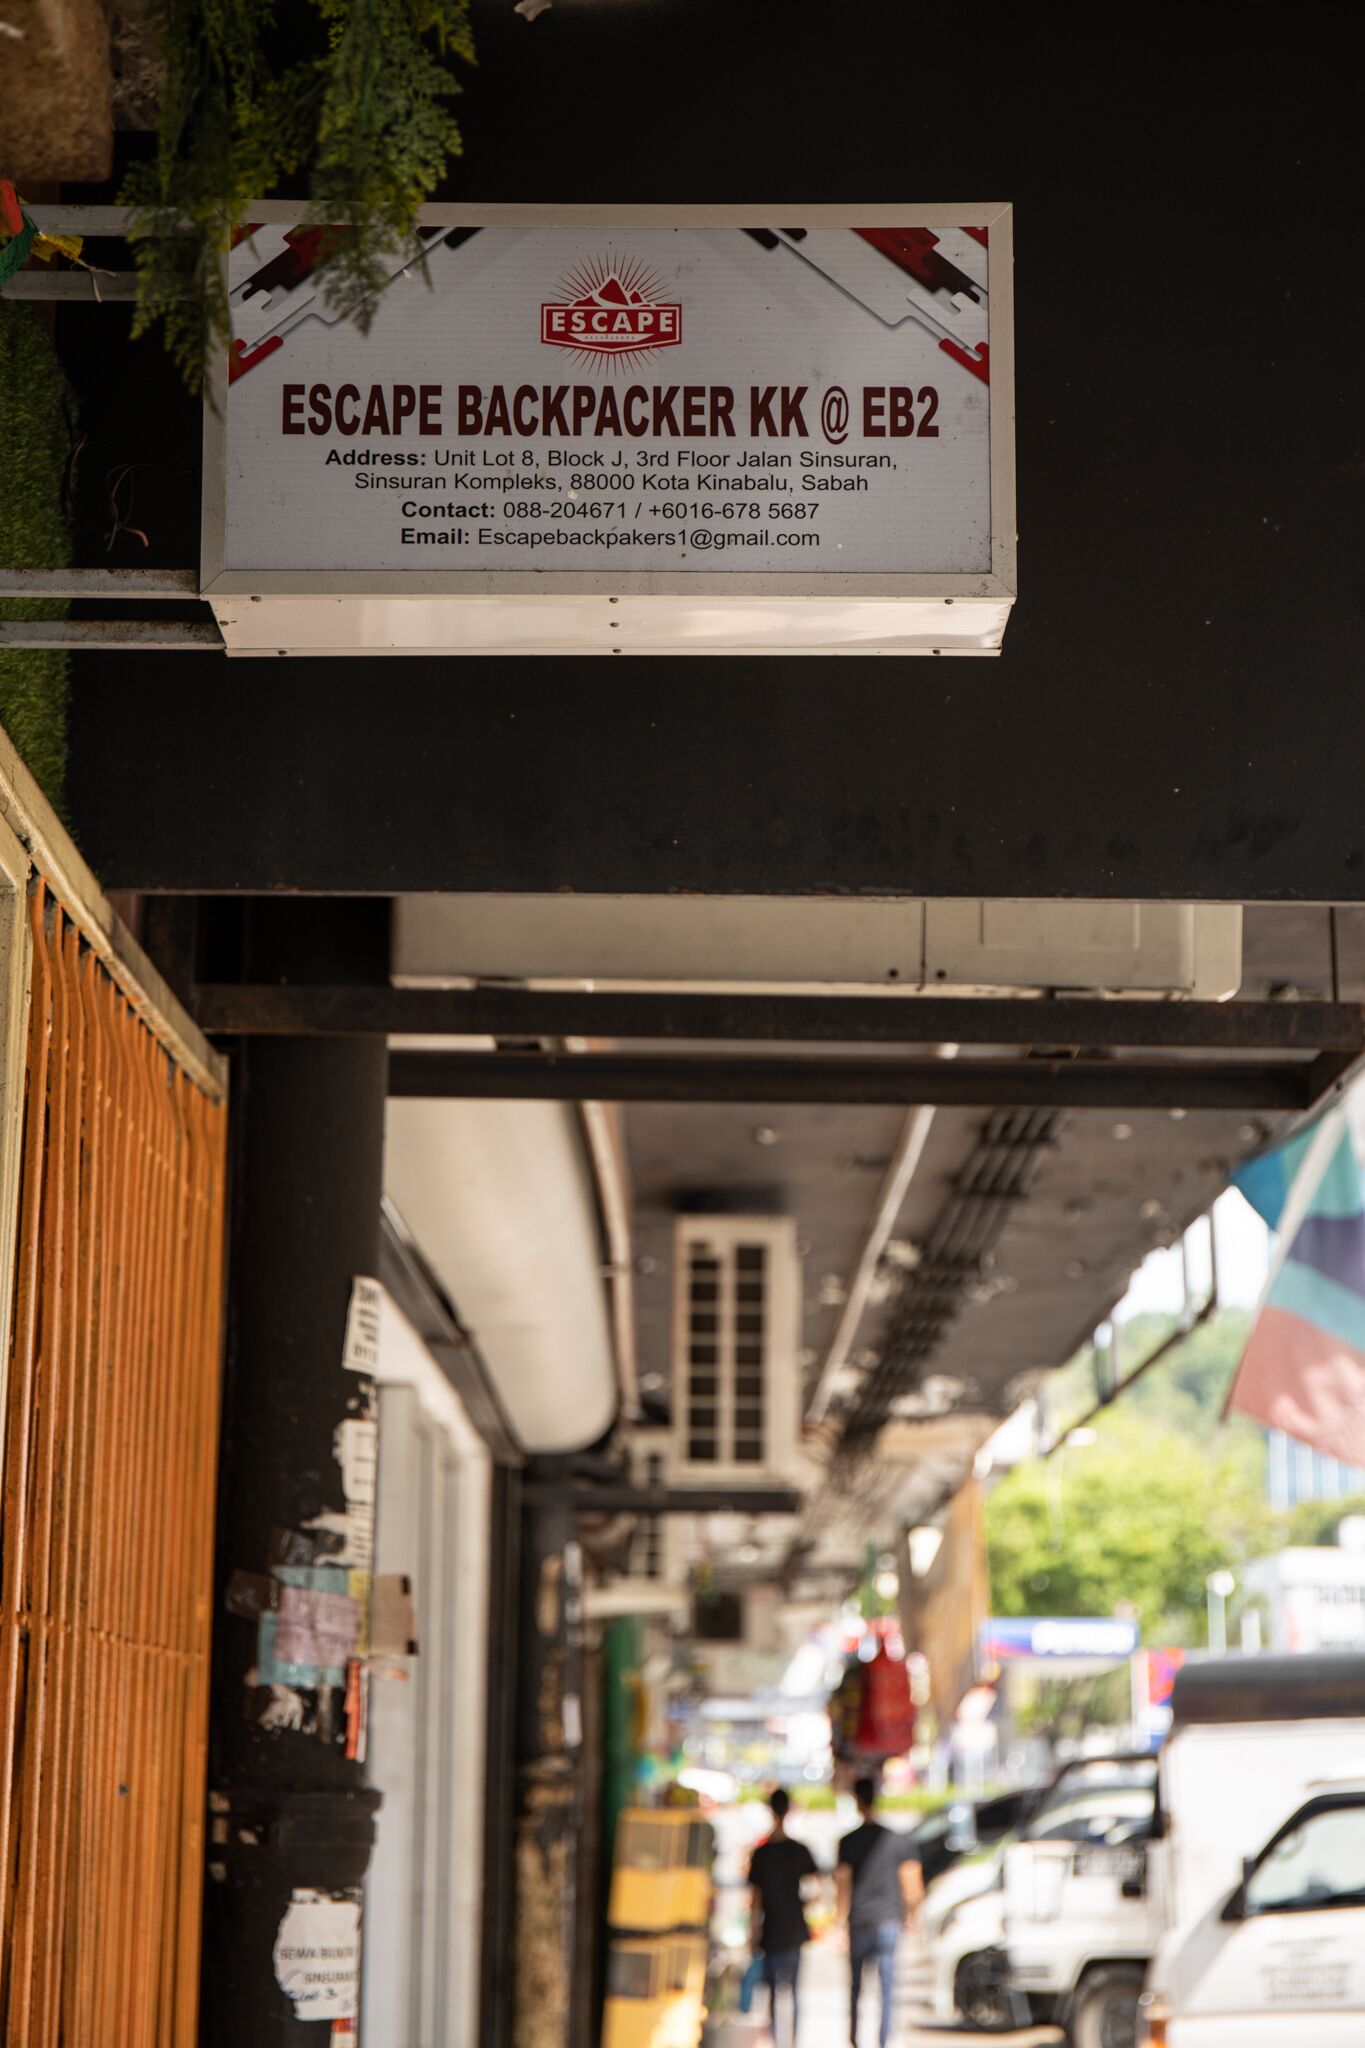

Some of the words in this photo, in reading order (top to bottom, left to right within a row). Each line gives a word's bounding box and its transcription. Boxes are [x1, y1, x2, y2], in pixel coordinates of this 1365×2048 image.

[551, 311, 673, 332] ESCAPE
[281, 383, 443, 437] ESCAPE
[457, 384, 737, 438] BACKPACKER
[750, 385, 810, 438] KK
[820, 385, 850, 445] @
[862, 385, 940, 438] EB2
[324, 448, 427, 467] Address:
[434, 449, 476, 467] Unit
[482, 449, 515, 467] Lot
[521, 450, 540, 470] 8,
[547, 450, 605, 467] Block
[611, 450, 629, 470] J,
[636, 450, 670, 468] 3rd
[677, 450, 730, 468] Floor
[736, 450, 792, 468] Jalan
[799, 450, 897, 471] Sinsuran,
[354, 472, 446, 490] Sinsuran
[454, 473, 563, 494] Kompleks,
[570, 473, 635, 491] 88000
[642, 473, 690, 491] Kota
[697, 473, 794, 494] Kinabalu,
[801, 474, 869, 492] Sabah
[401, 501, 496, 519] Contact:
[502, 501, 625, 519] 088-204671
[634, 502, 643, 520] /
[648, 502, 761, 520] +6016-678
[768, 503, 820, 520] 5687
[400, 527, 470, 545] Email:
[478, 527, 820, 551] Escapebackpakers1@gmail.com
